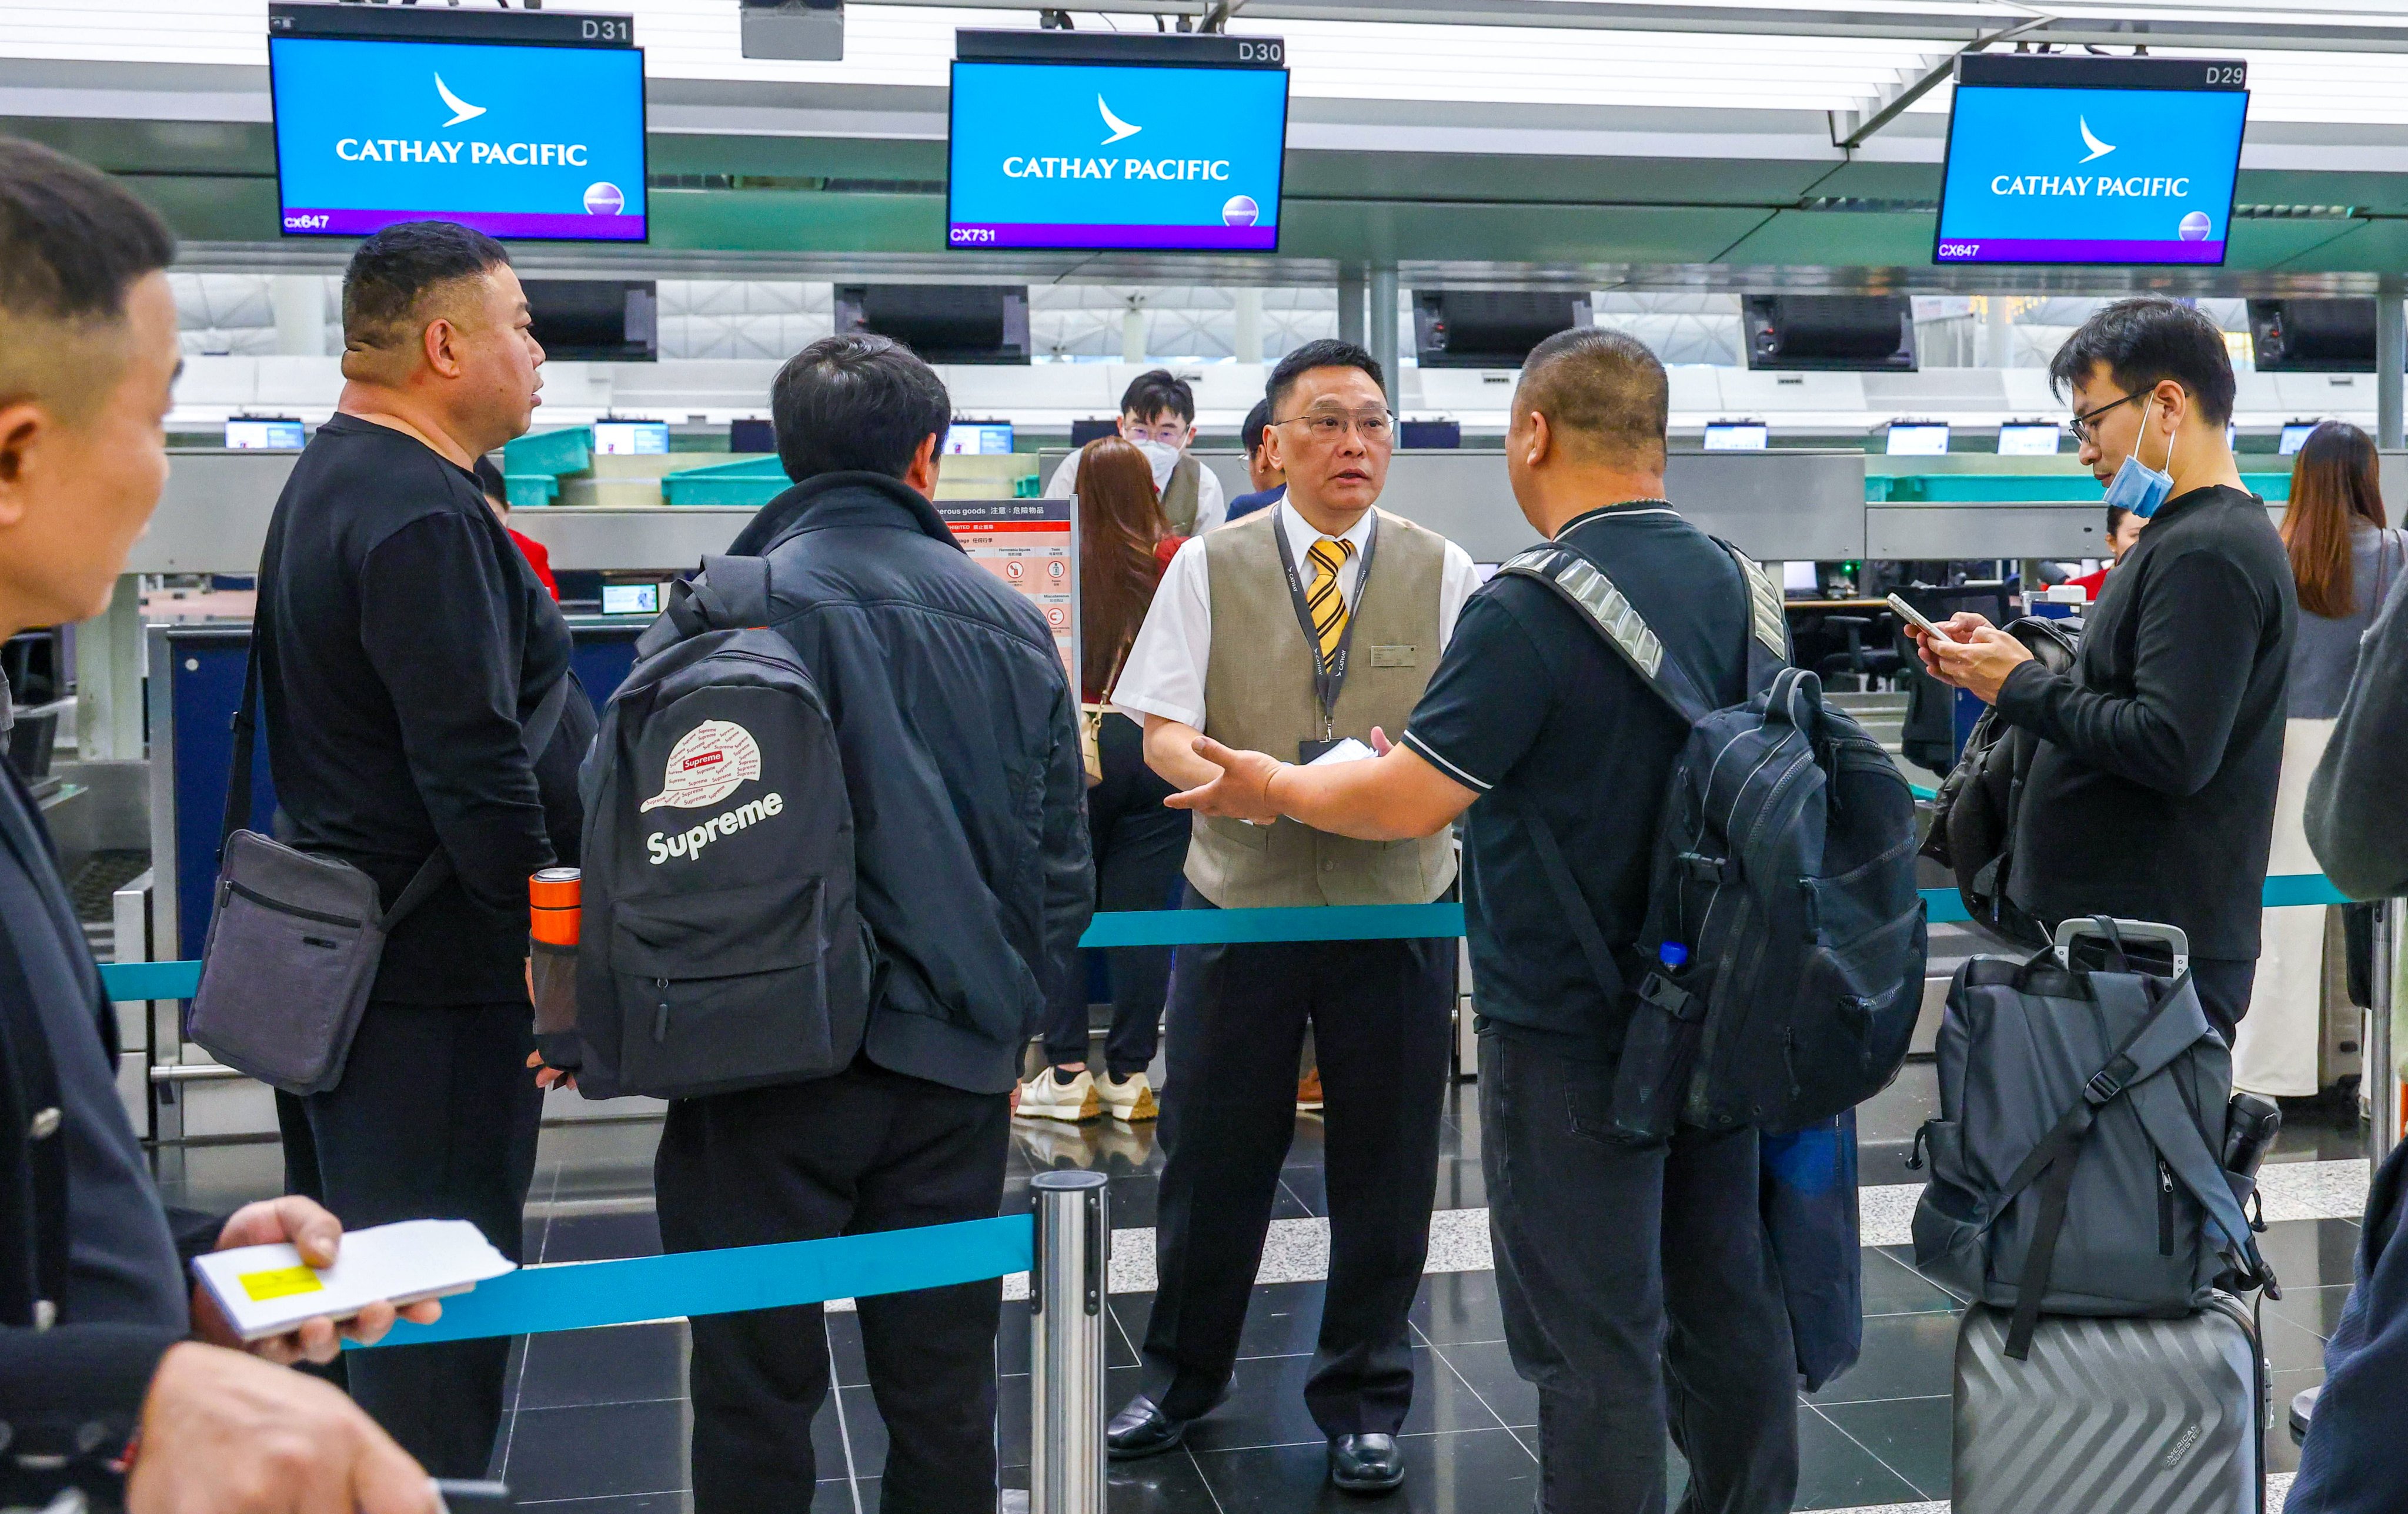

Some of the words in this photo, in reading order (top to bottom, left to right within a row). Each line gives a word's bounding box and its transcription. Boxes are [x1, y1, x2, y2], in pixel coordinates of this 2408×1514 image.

[582, 20, 627, 40] D31
[1239, 42, 1282, 62] D30
[2206, 66, 2244, 85] D29
[336, 138, 464, 163] CATHAY
[470, 142, 587, 166] PACIFIC
[1003, 156, 1118, 179] CATHAY
[1124, 159, 1230, 181] PACIFIC
[1991, 175, 2093, 196] CATHAY
[2096, 177, 2189, 197] PACIFIC
[950, 228, 996, 242] CX731
[1938, 244, 1980, 257] CX647
[962, 507, 986, 516] goods
[1289, 573, 1298, 592] CATHAY
[1338, 649, 1347, 671] CATHAY
[684, 753, 722, 768] Supreme
[646, 792, 784, 865] Supreme
[2168, 1429, 2200, 1466] OURISTE
